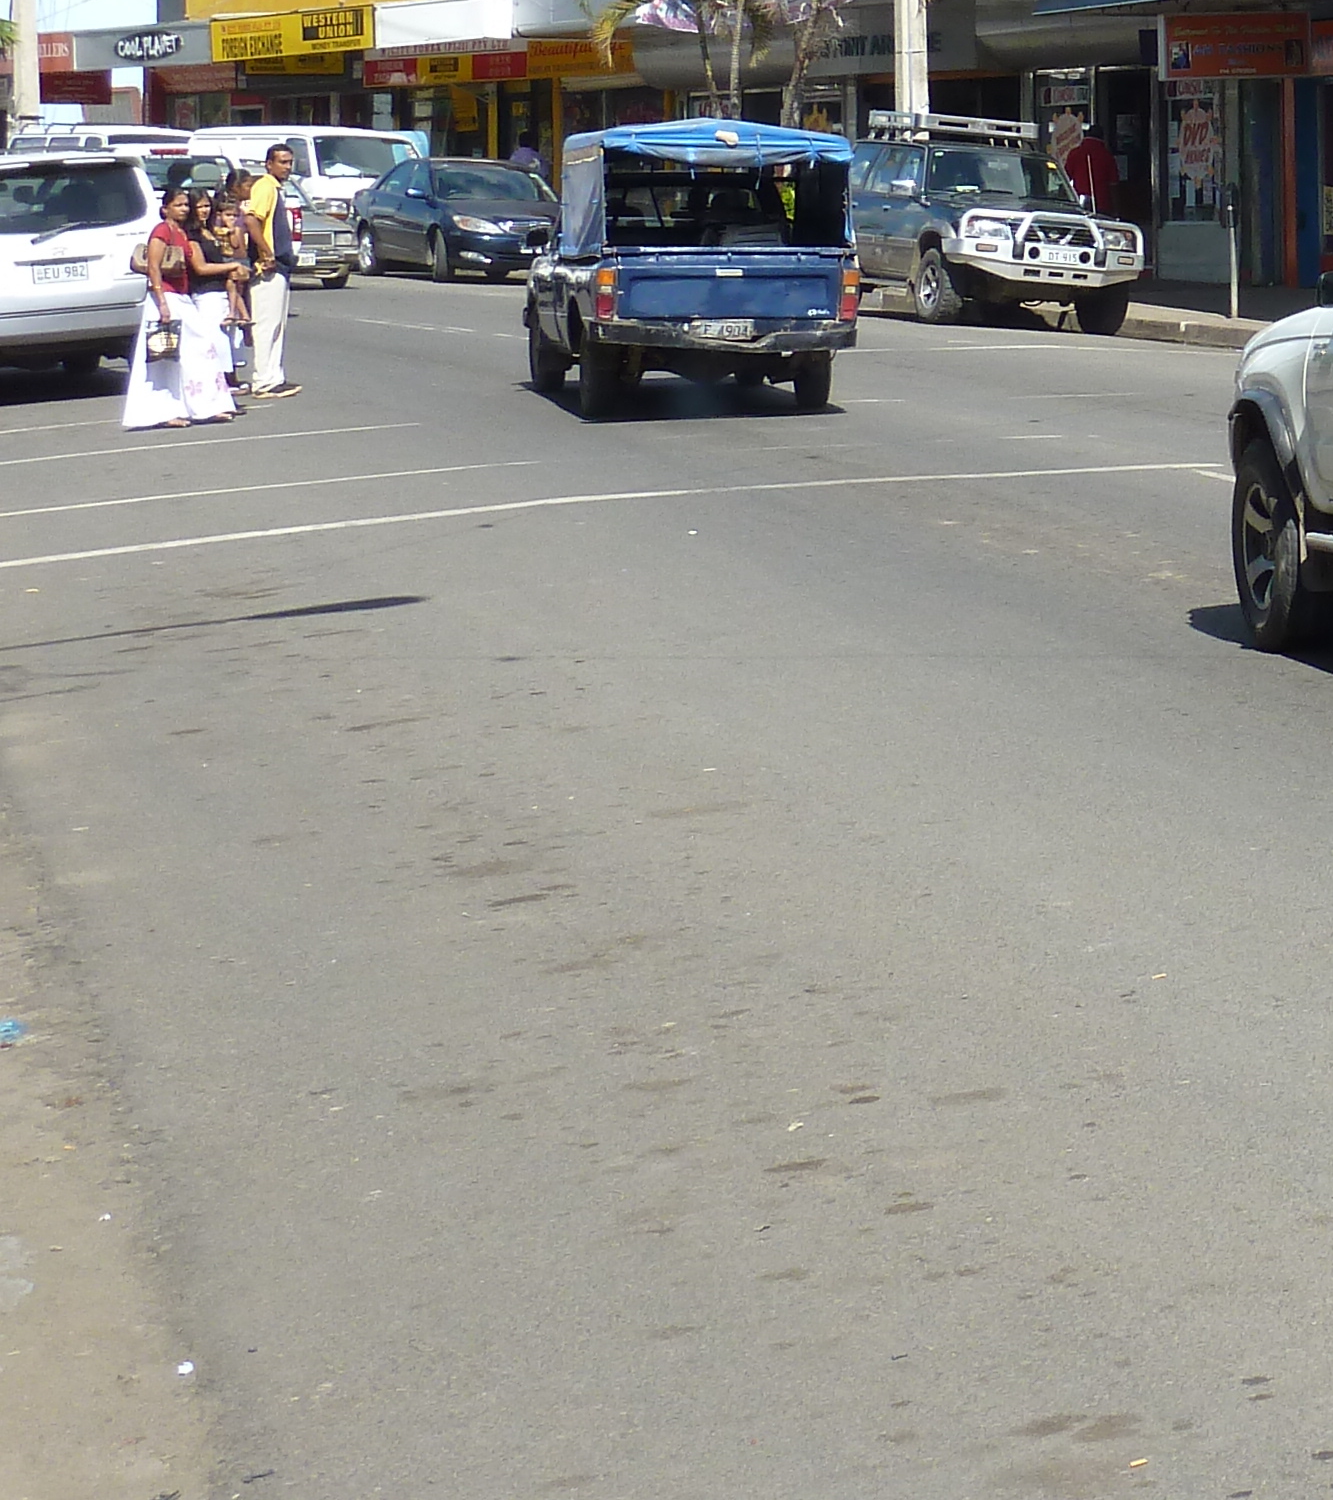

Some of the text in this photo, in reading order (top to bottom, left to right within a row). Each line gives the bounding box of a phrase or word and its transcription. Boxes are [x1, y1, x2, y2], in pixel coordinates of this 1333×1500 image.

[303, 10, 353, 28] WESTERN
[318, 24, 353, 39] UNION
[118, 34, 179, 59] COOL PLANET
[44, 264, 86, 281] EU 982
